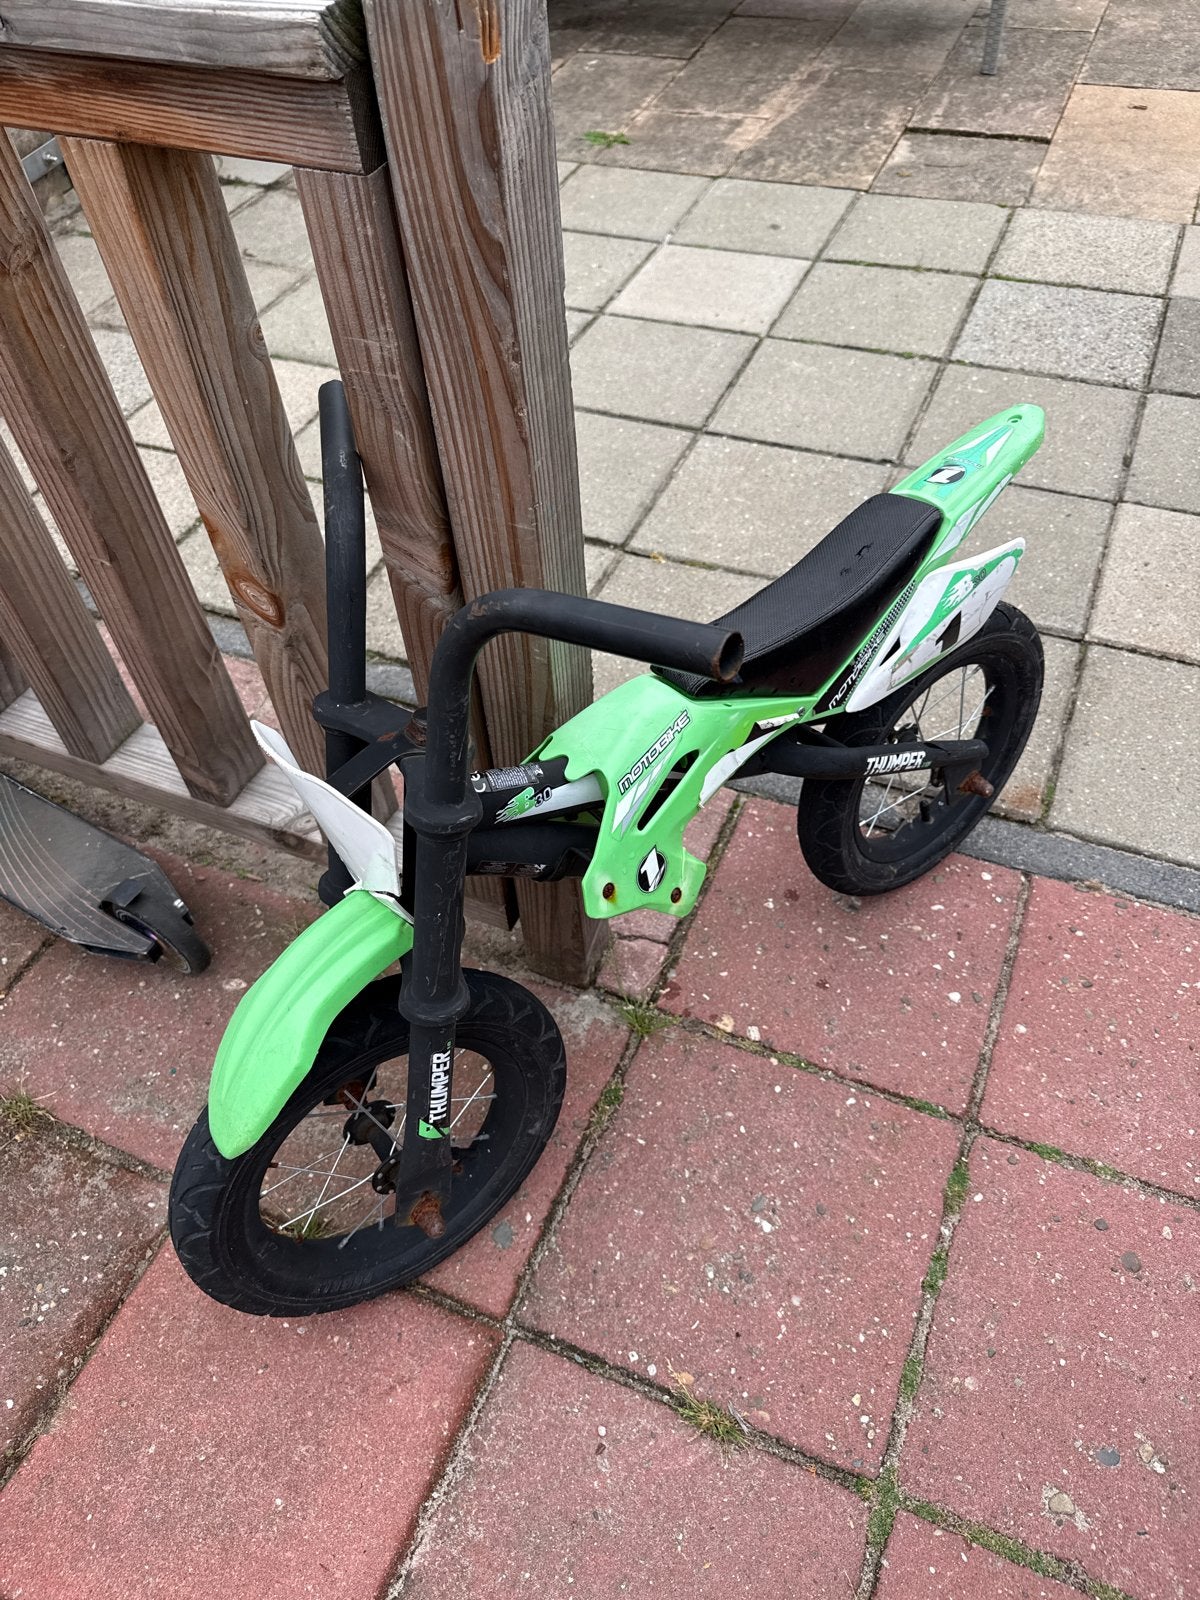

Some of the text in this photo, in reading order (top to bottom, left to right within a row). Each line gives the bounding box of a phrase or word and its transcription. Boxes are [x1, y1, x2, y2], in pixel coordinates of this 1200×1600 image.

[617, 709, 691, 796] MOTOBIKE
[863, 750, 926, 776] THUMPER
[639, 845, 665, 893] 1
[428, 1049, 451, 1125] THUMPER
